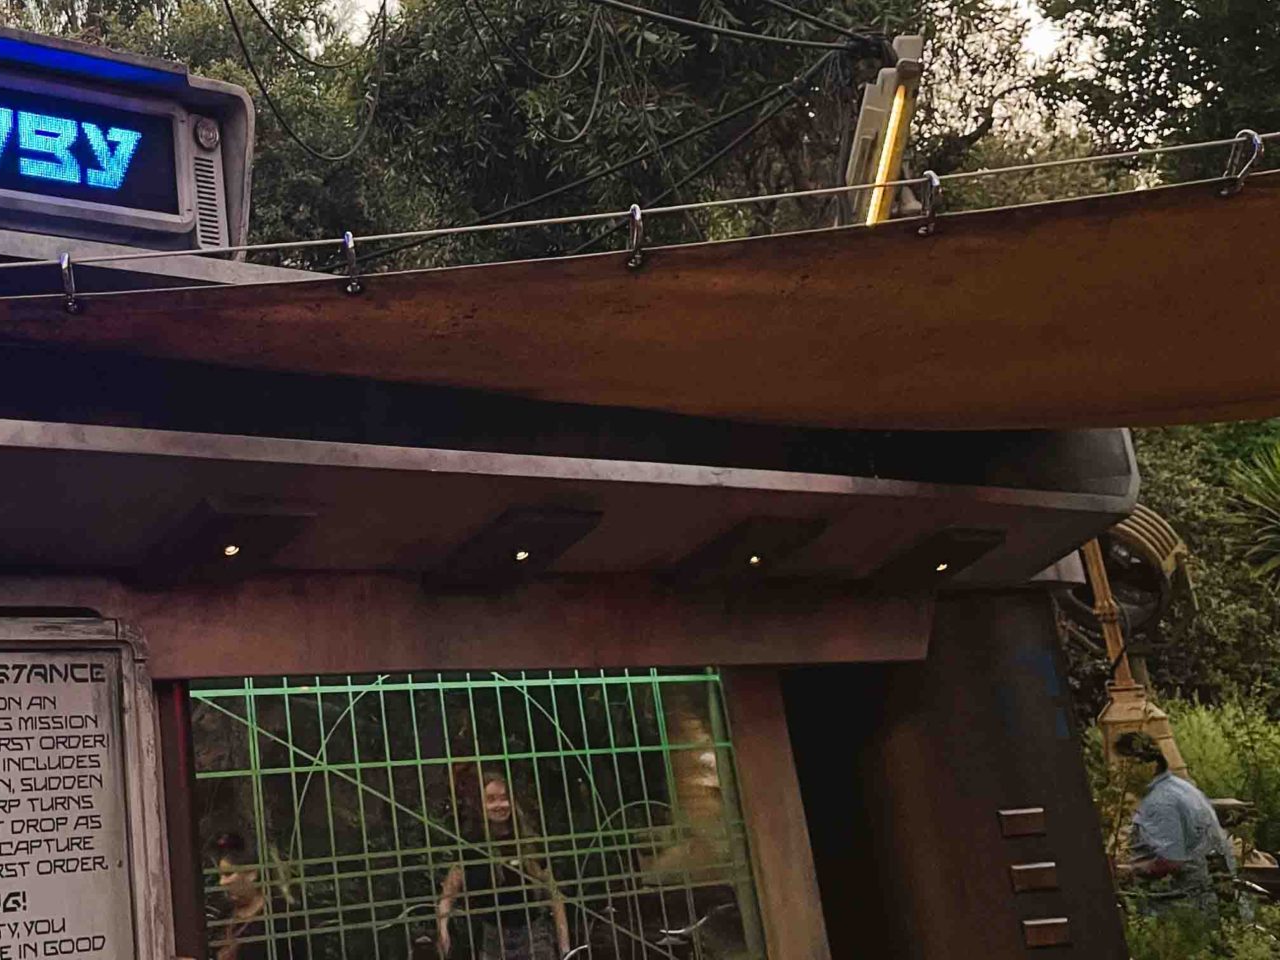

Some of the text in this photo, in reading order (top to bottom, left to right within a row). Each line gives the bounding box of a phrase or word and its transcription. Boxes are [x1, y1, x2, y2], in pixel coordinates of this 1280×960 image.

[26, 696, 57, 710] AN
[19, 715, 98, 731] MISSION
[39, 734, 110, 750] ORDER!
[2, 754, 101, 771] INCLUDES
[20, 774, 103, 792] SUDDEN
[29, 795, 94, 812] TURNS
[11, 817, 68, 834] DROP
[73, 815, 102, 830] AS
[0, 836, 95, 855] CAPTURE
[36, 856, 109, 874] ORDER.
[23, 917, 65, 936] YOU
[19, 942, 37, 959] IN
[44, 935, 105, 956] GOOD
